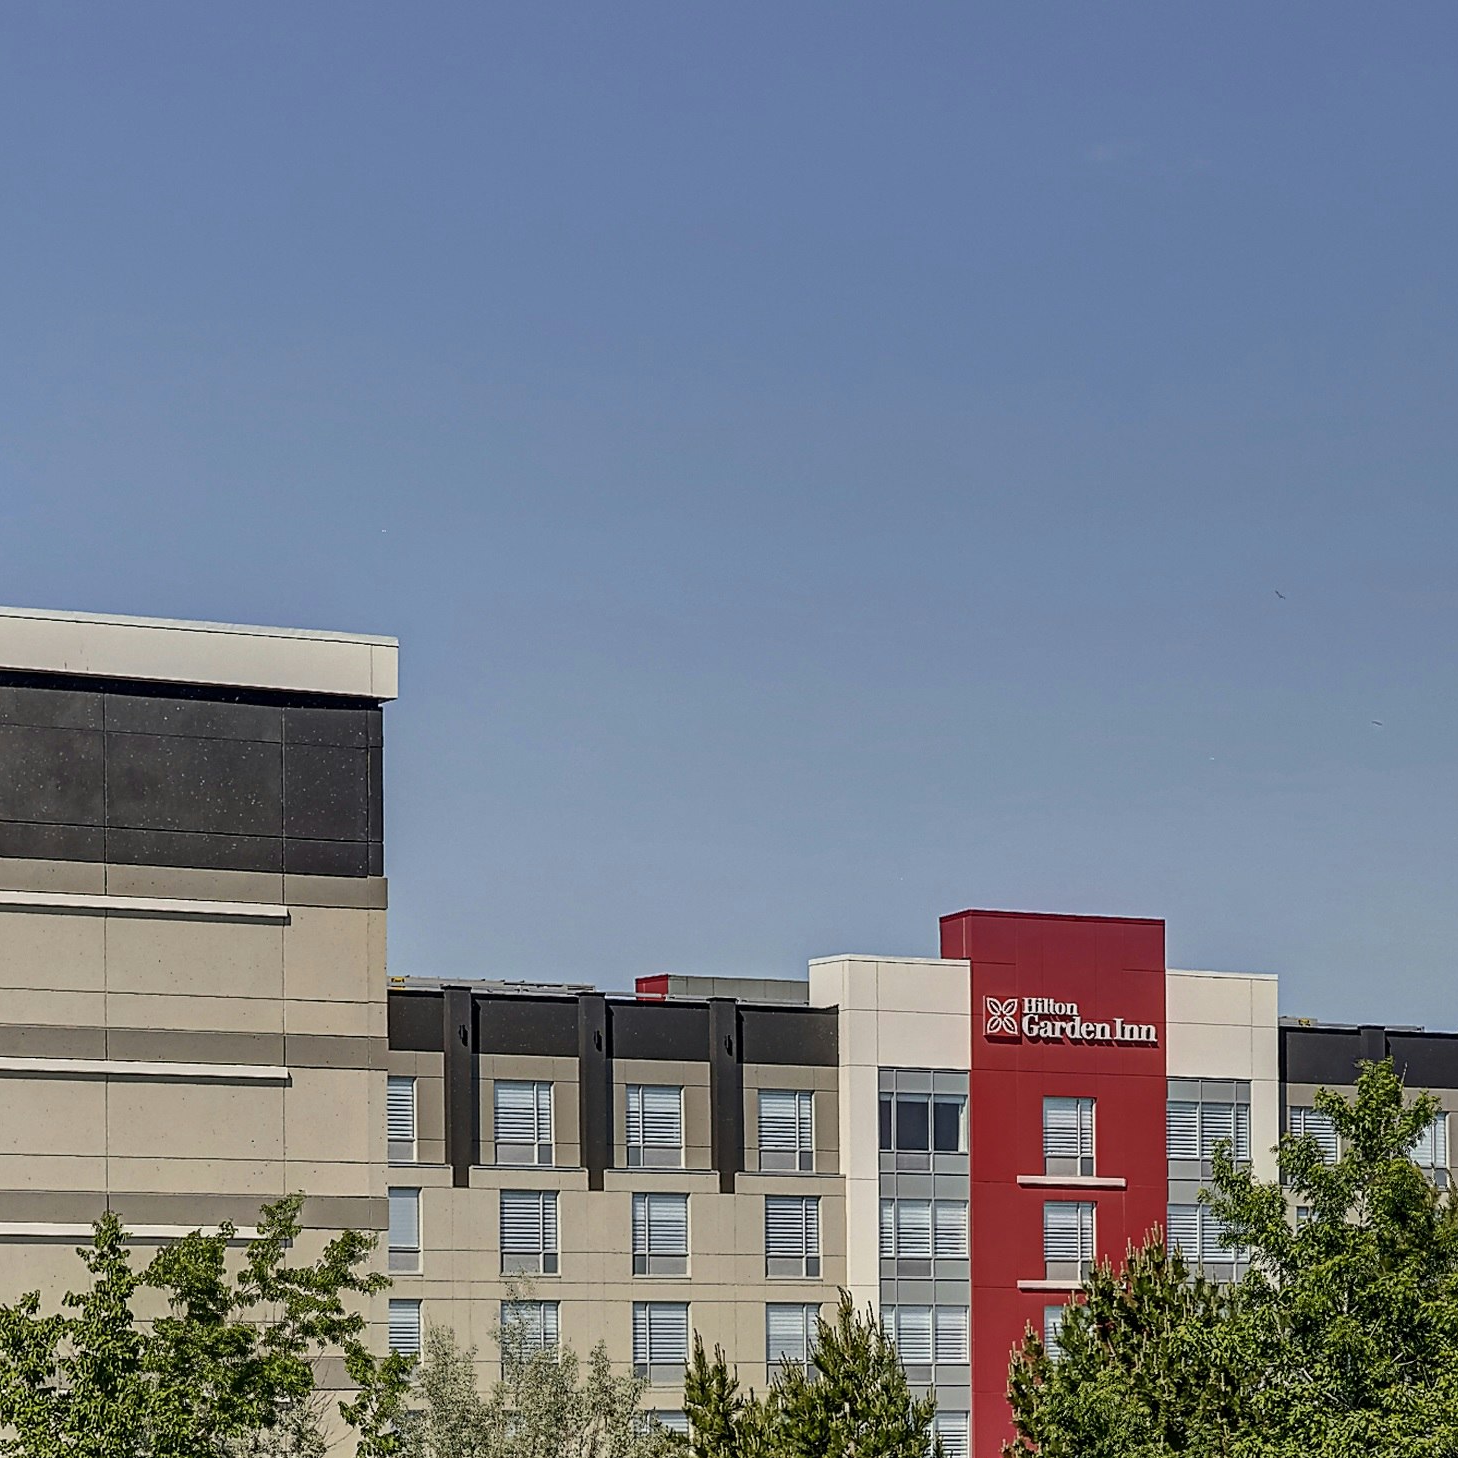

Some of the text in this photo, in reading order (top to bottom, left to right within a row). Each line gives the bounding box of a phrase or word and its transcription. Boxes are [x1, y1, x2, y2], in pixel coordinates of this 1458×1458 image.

[1022, 997, 1078, 1015] Hilton
[1022, 1014, 1158, 1042] Garden Inn
